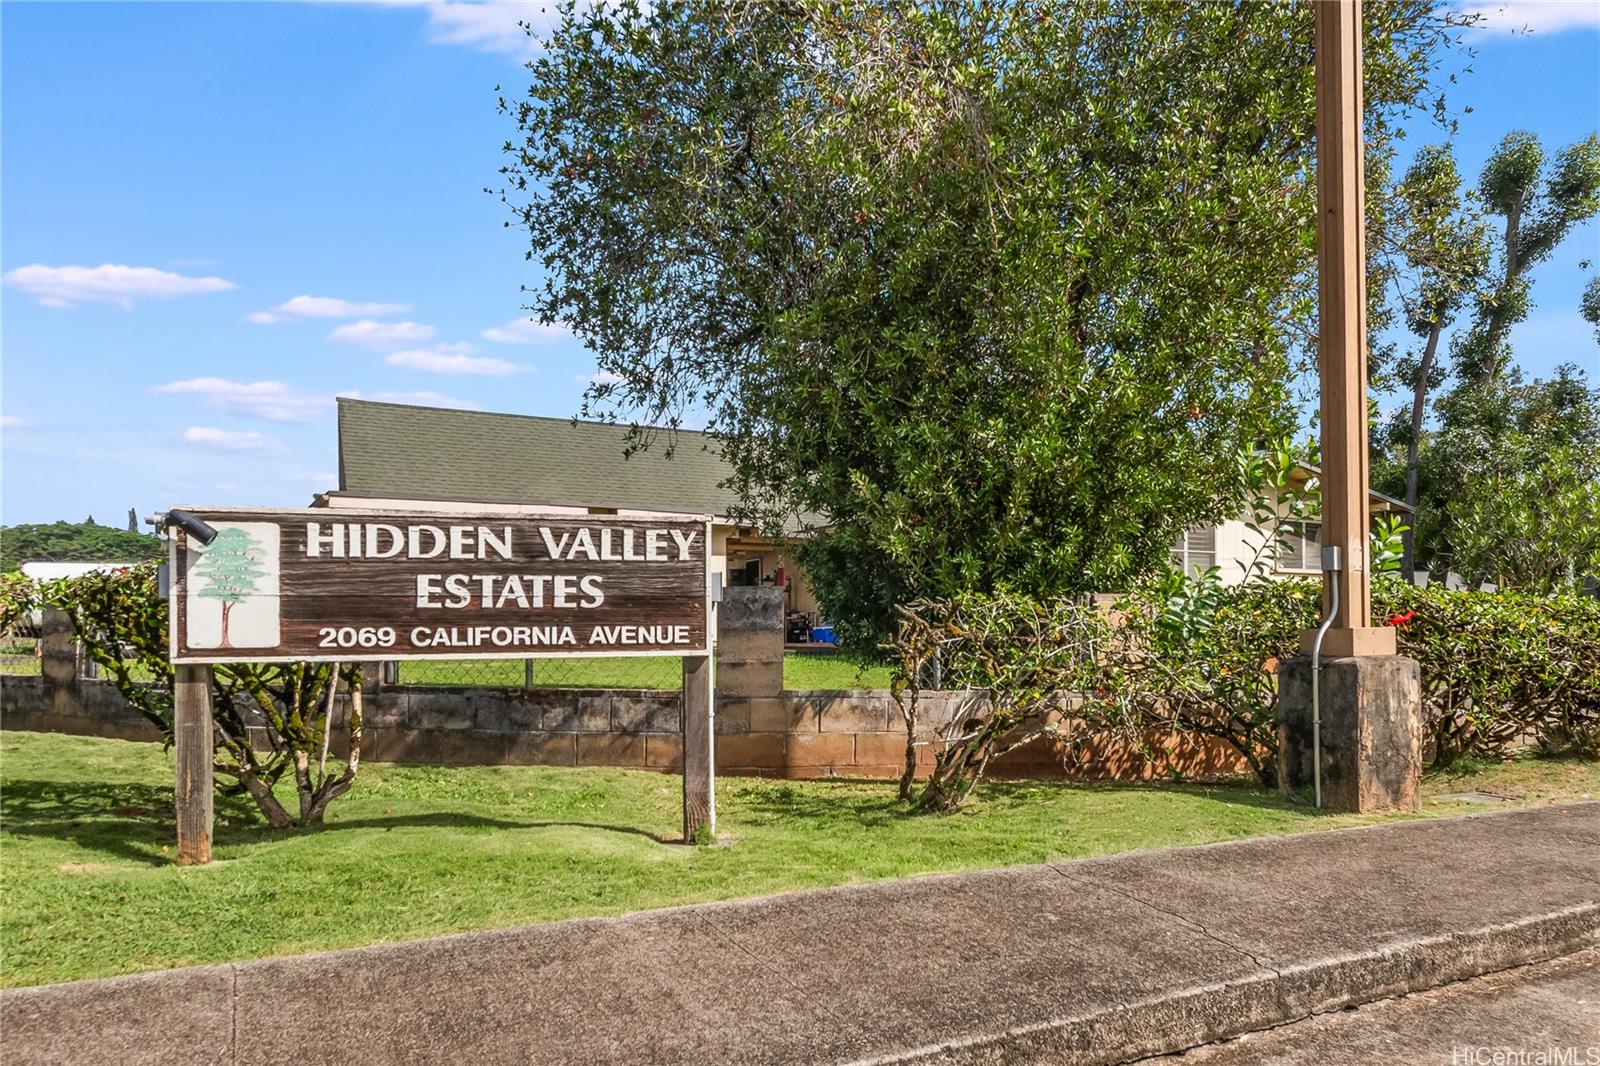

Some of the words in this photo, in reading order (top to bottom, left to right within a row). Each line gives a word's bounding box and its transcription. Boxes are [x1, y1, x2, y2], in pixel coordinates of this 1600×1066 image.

[306, 522, 512, 559] HIDDEN
[539, 527, 697, 561] VALLEY
[416, 574, 605, 609] ESTATES
[319, 626, 396, 648] 2069
[410, 625, 577, 647] CALIFORNIA
[589, 625, 690, 645] AVENUE
